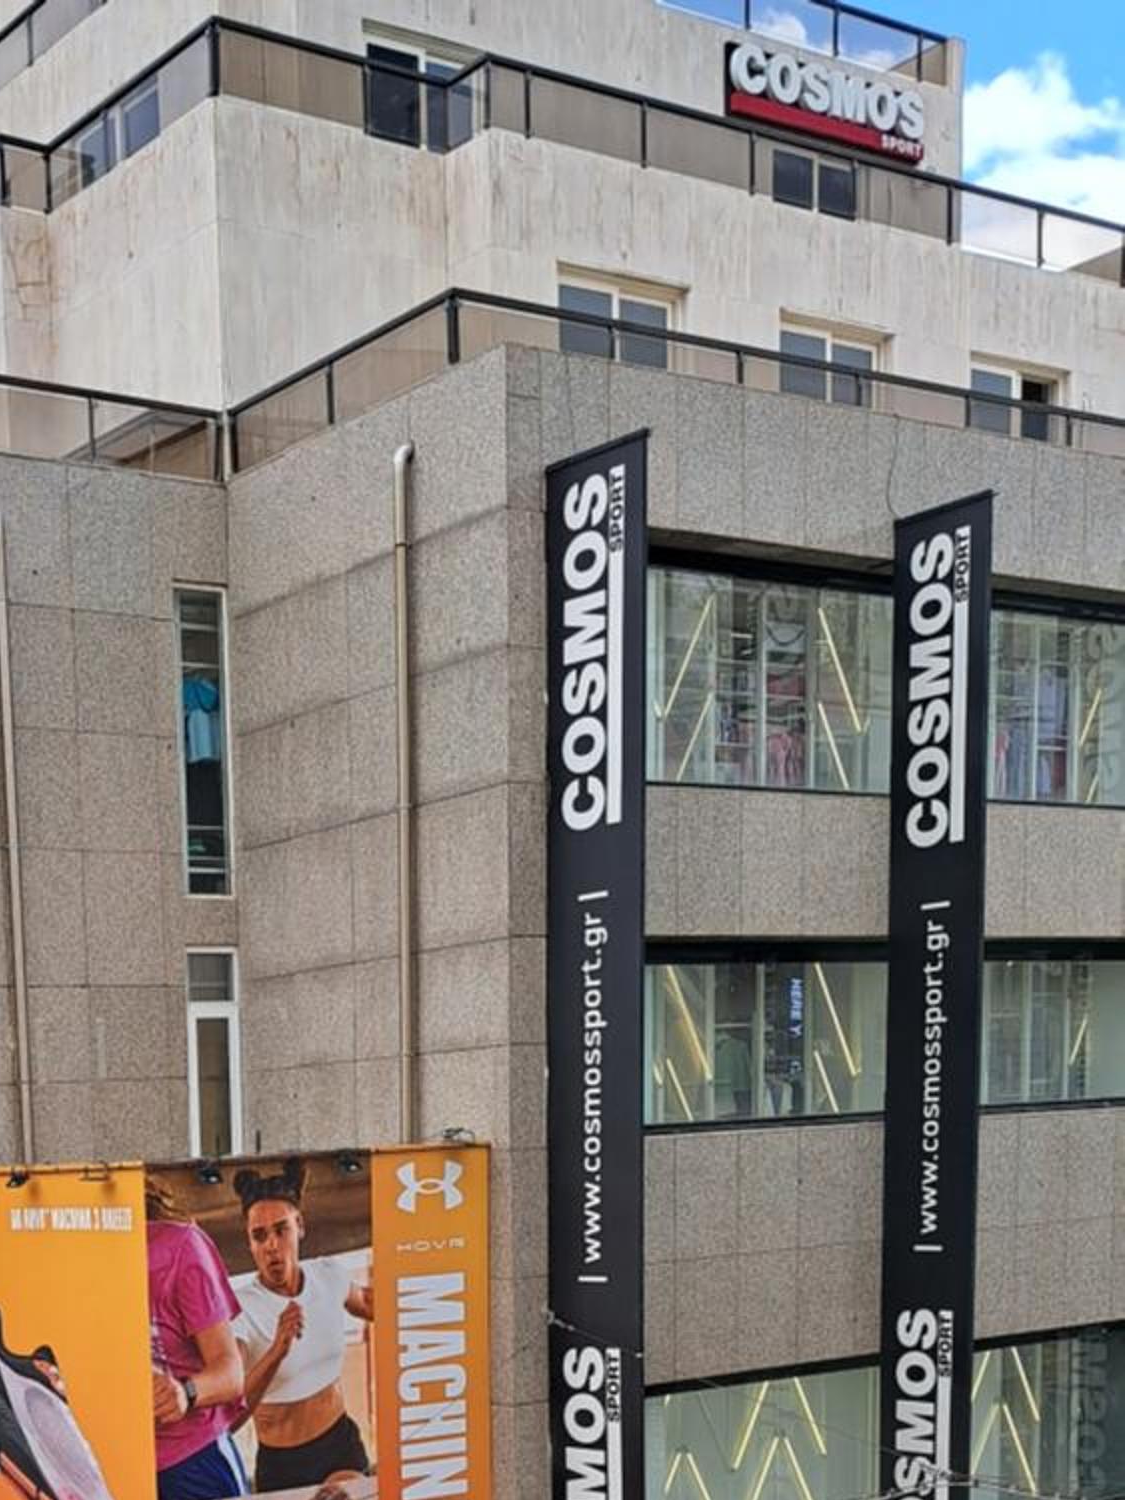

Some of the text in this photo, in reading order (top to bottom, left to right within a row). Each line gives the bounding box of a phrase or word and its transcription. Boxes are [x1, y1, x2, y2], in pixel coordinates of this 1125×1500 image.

[730, 43, 924, 139] COSMOS
[881, 133, 924, 160] SPORT
[608, 464, 625, 553] SPORT
[954, 526, 971, 602] SPORT
[562, 473, 608, 830] COSMOS
[906, 531, 954, 848] COSMOS
[579, 912, 608, 1263] www.cosmossport.gr
[920, 917, 950, 1235] www.cosmossport.gr
[607, 1348, 621, 1423] SPORT
[938, 1310, 954, 1378] SPORT
